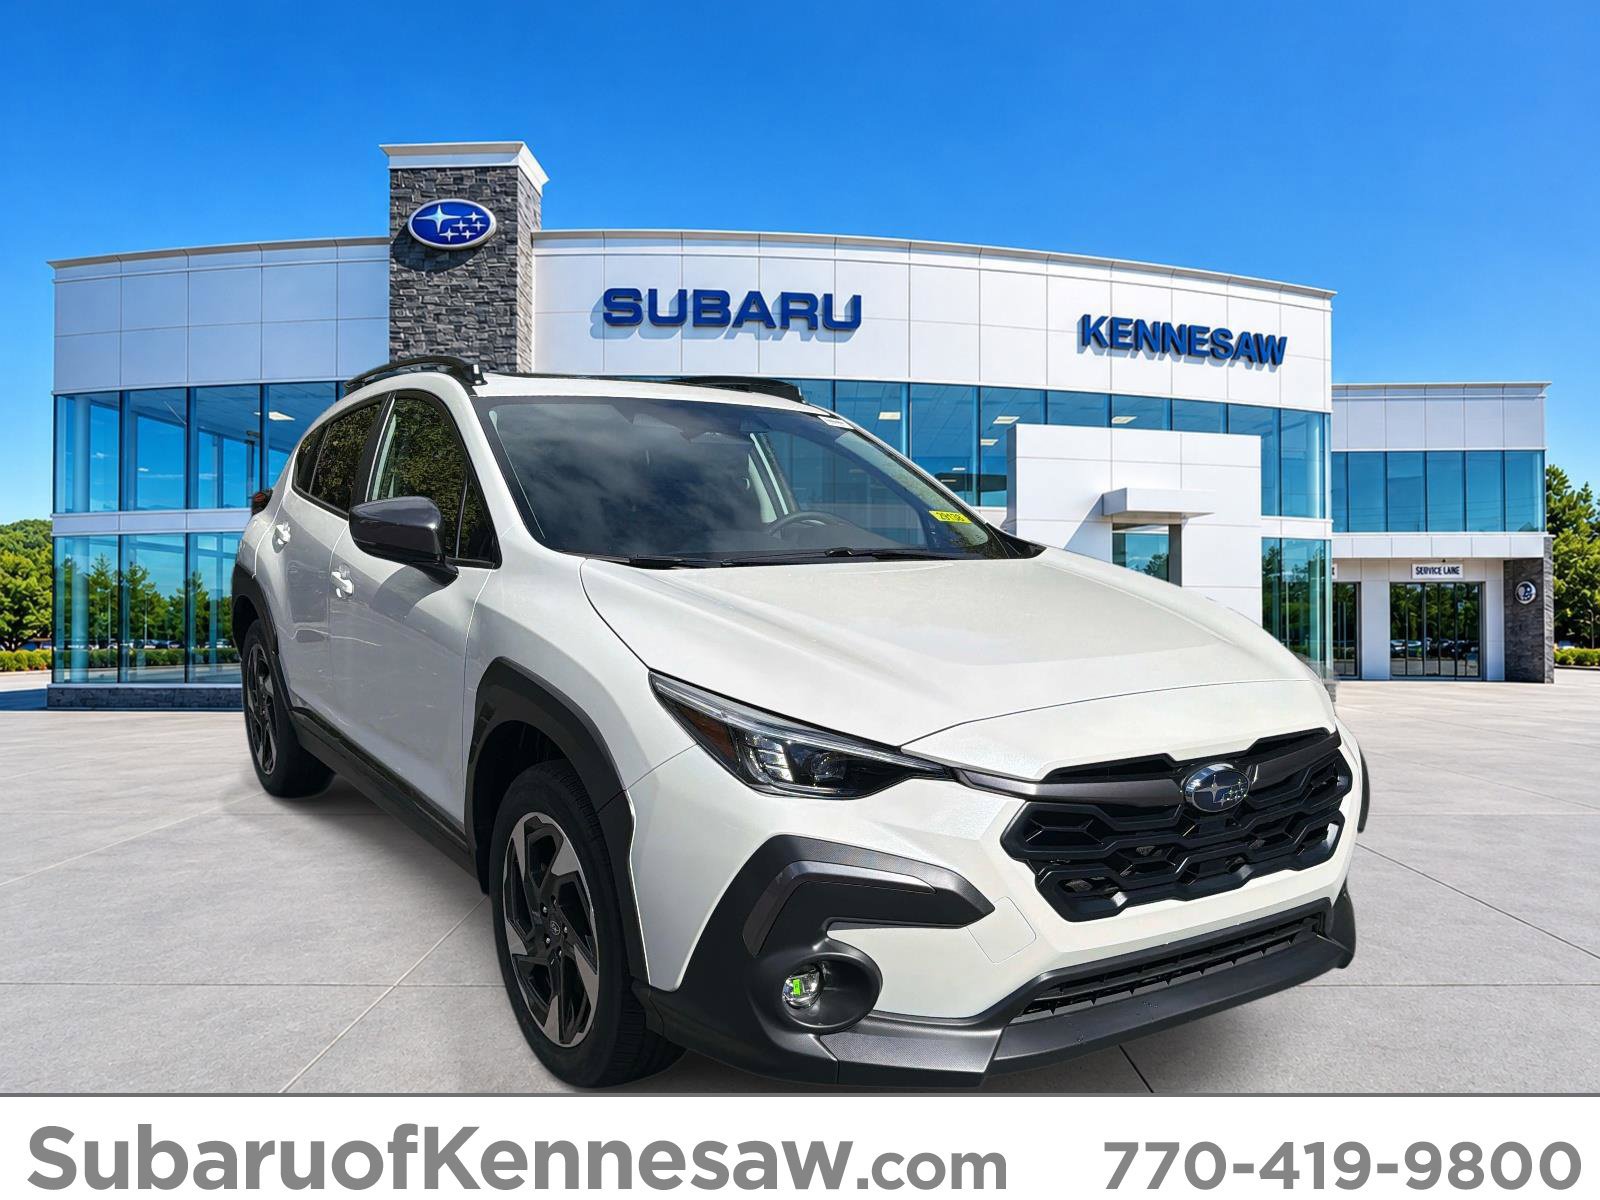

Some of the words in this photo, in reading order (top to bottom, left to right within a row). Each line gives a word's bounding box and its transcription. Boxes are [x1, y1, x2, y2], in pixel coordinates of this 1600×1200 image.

[602, 288, 863, 331] SUBARU
[1080, 314, 1288, 366] KENNESAW
[1415, 566, 1442, 575] SERVICE
